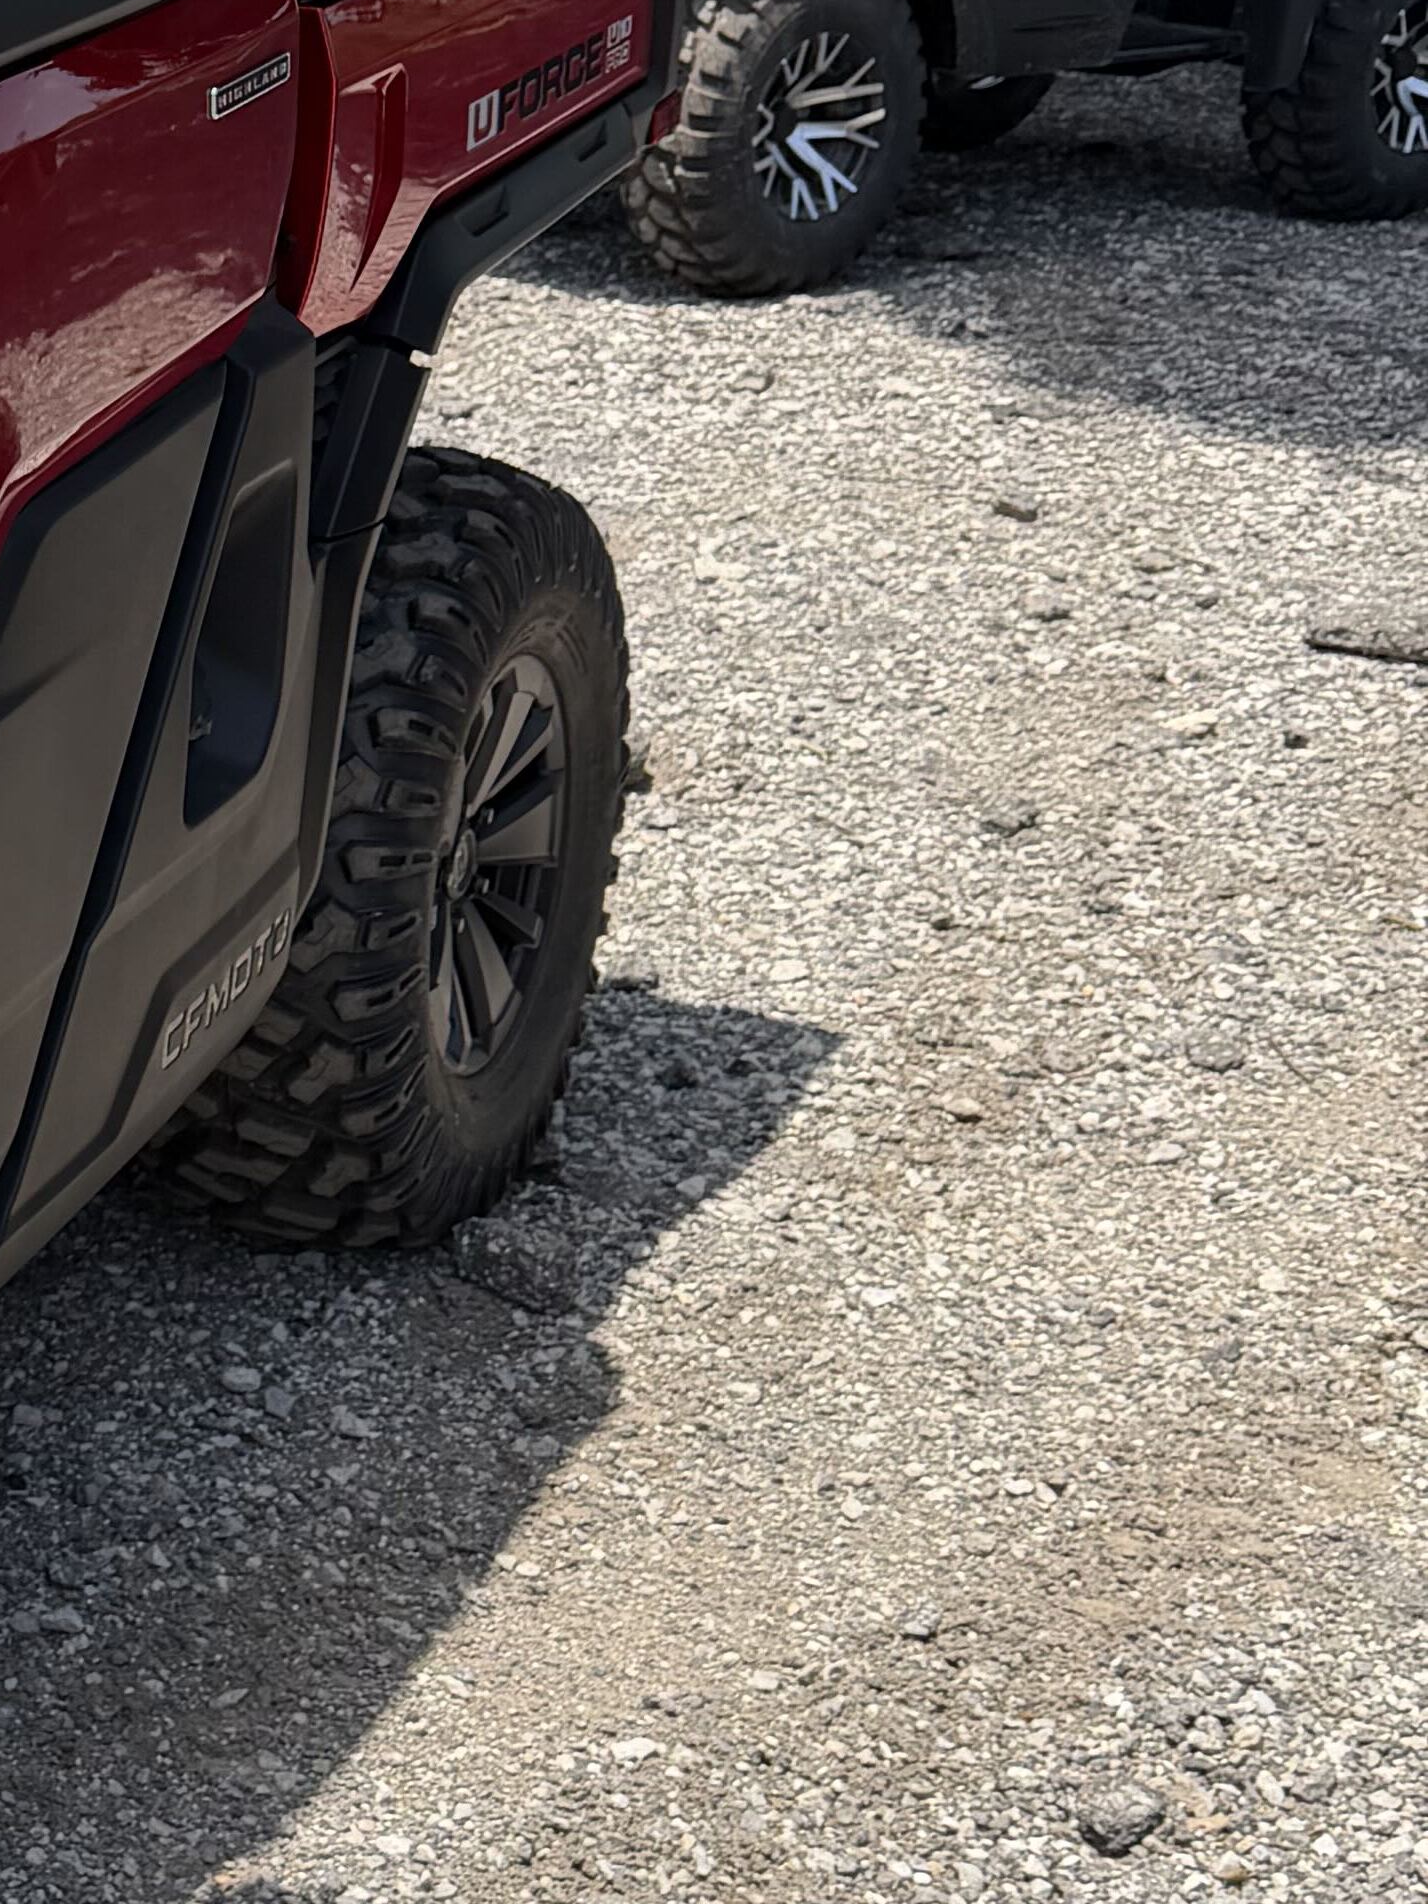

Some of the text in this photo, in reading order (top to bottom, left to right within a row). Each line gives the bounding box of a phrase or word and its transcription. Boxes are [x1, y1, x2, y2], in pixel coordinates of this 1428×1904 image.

[218, 61, 287, 109] HIGHLAND
[467, 30, 606, 152] UFORCE
[161, 907, 292, 1070] CFMOTO
